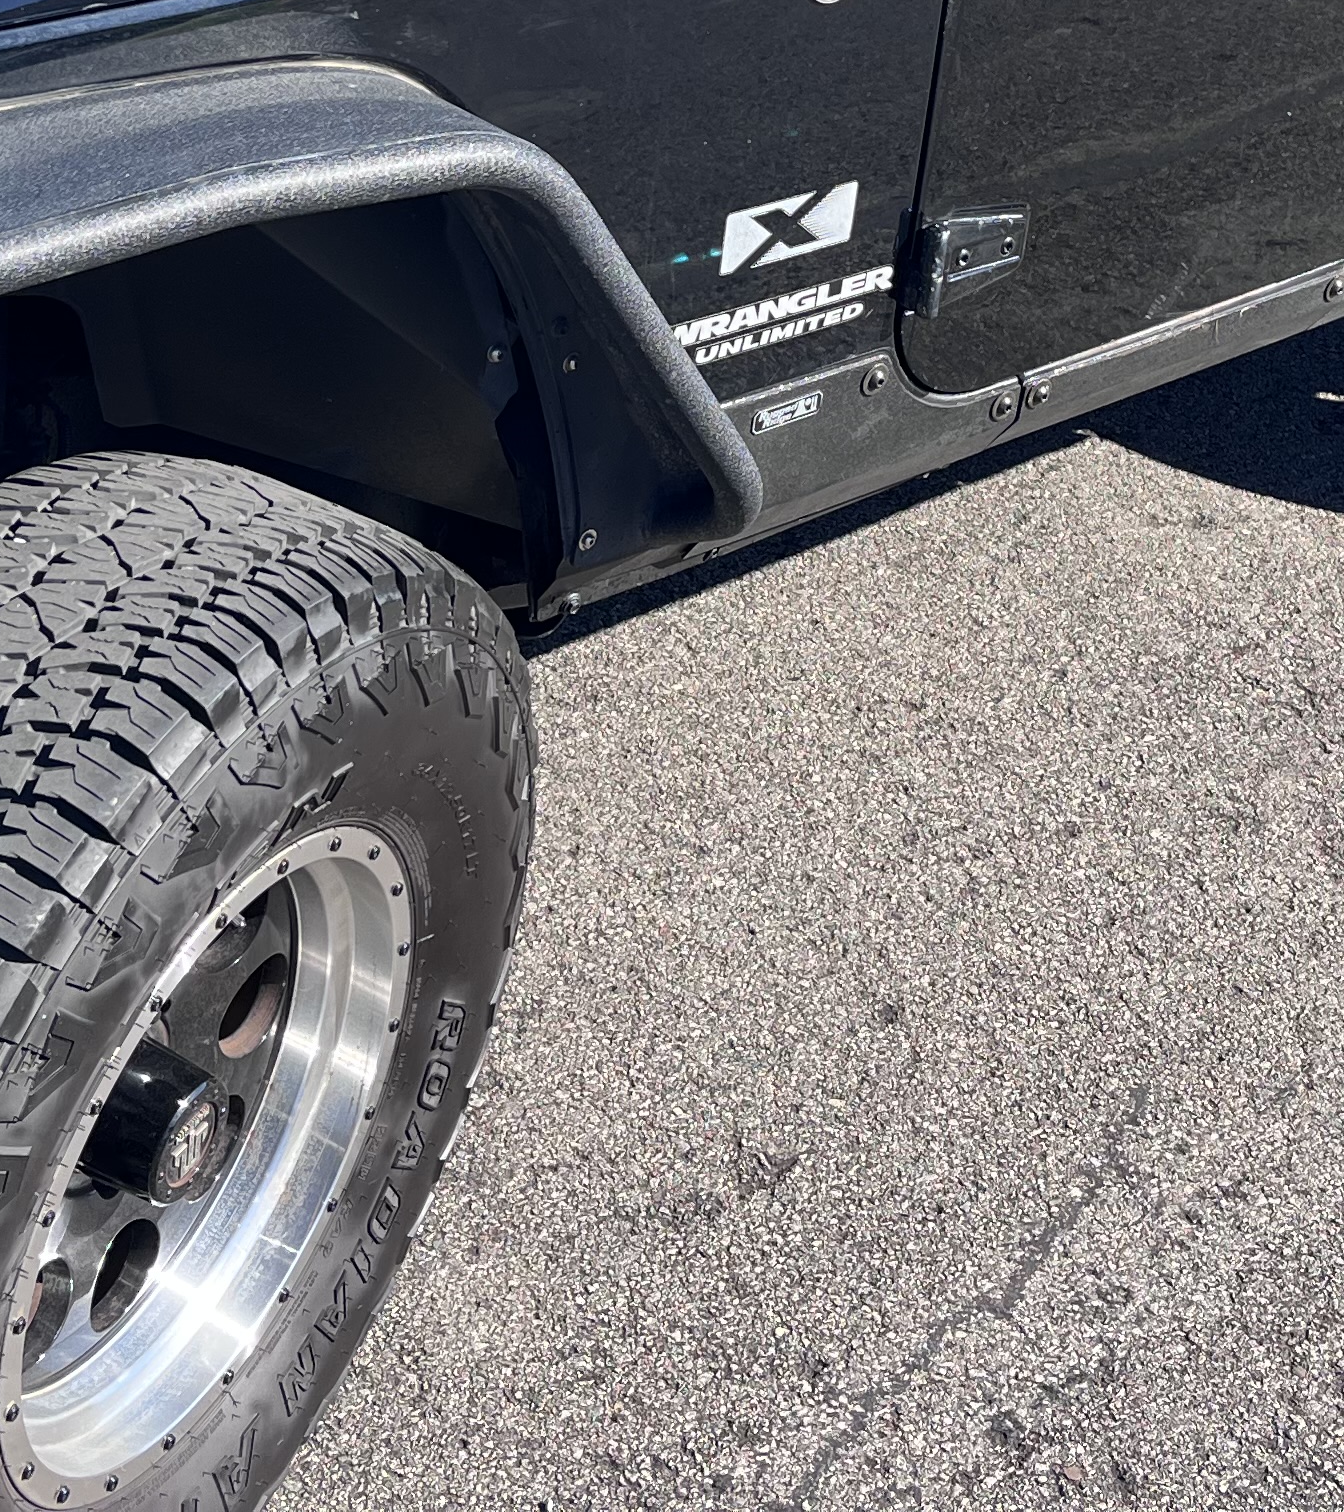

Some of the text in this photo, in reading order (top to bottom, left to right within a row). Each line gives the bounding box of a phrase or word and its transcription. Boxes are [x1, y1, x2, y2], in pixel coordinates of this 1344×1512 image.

[673, 264, 895, 346] WRANGLER
[695, 302, 864, 365] UNLIMITED
[278, 999, 466, 1419] ROADIAN
